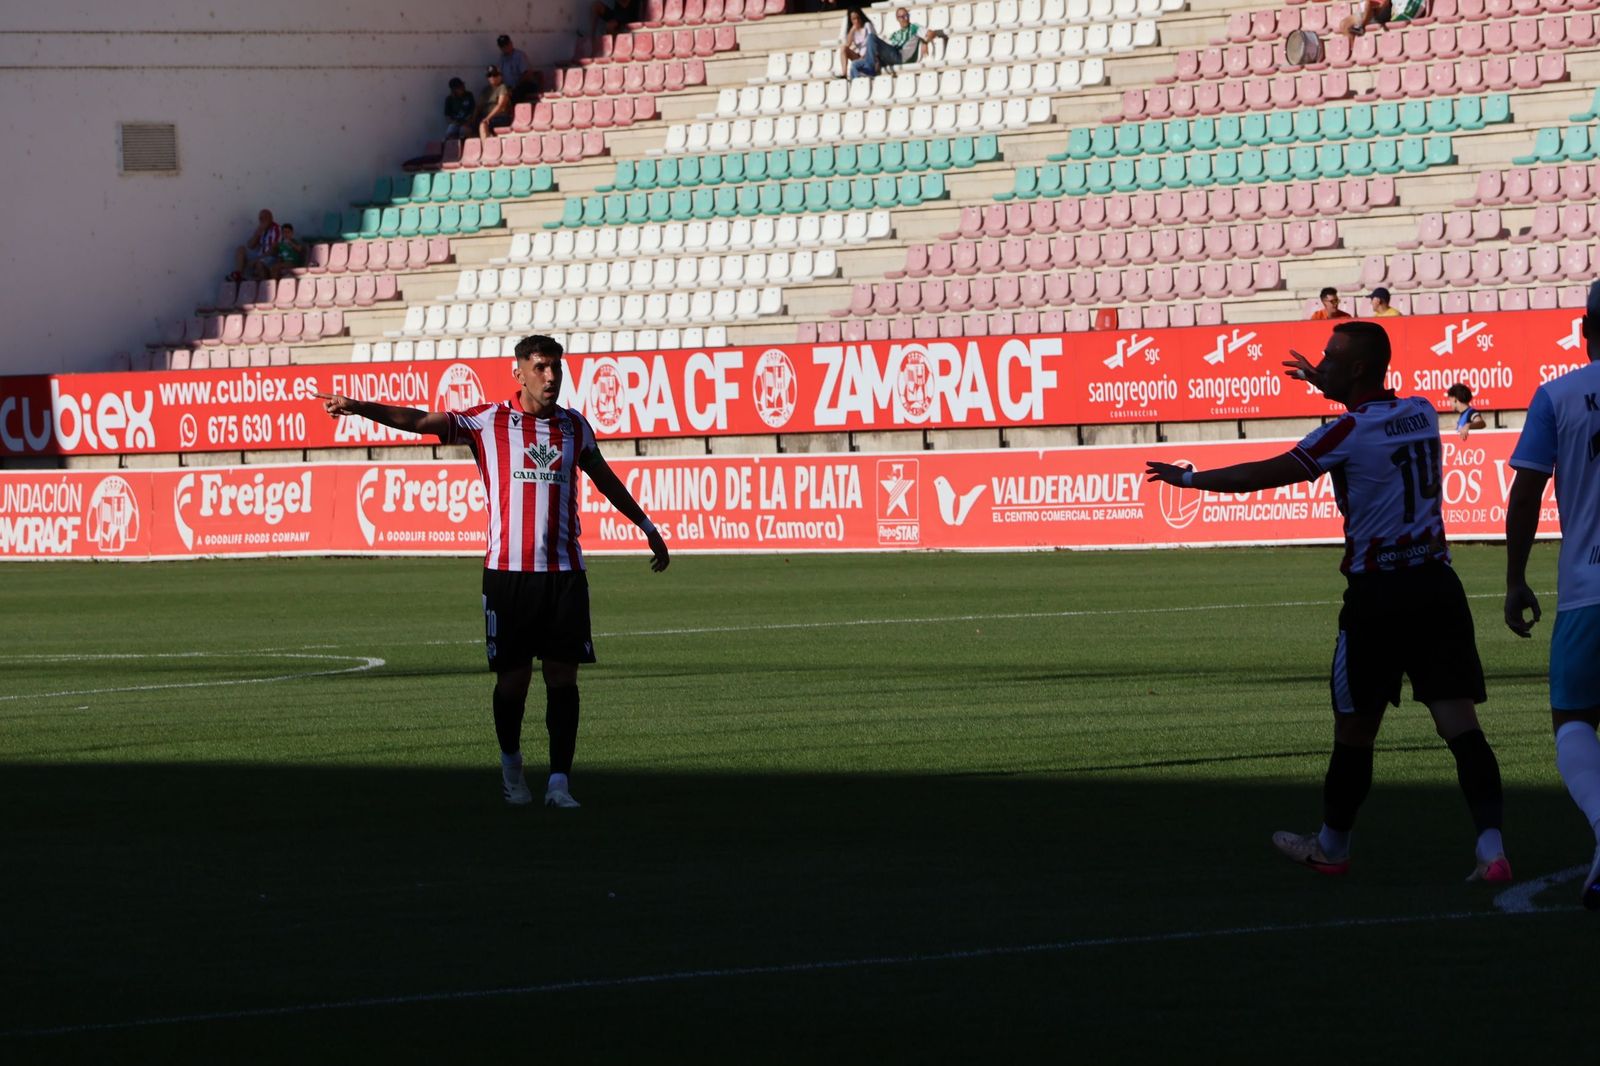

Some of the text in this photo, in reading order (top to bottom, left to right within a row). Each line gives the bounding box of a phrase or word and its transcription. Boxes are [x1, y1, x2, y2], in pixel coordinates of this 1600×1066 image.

[1145, 348, 1160, 365] sgc
[1247, 343, 1263, 360] sgc
[1476, 333, 1494, 351] sgc
[159, 372, 318, 406] www.cubiex.es
[332, 365, 429, 402] FUNDACIÓN
[560, 351, 743, 435] MORA CF
[812, 338, 1063, 426] ZAMORA CF
[1088, 374, 1178, 408] sangregorio
[1188, 370, 1281, 405] sangregorio
[1413, 361, 1513, 397] sangregorio
[0, 378, 156, 452] cubiex
[207, 415, 239, 444] 675
[242, 413, 272, 443] 630
[277, 412, 305, 441] 110
[513, 471, 569, 483] CAJA RURAL
[725, 466, 752, 510] DE
[760, 466, 787, 510] LA
[795, 465, 863, 509] PLATA
[991, 473, 1144, 505] VALDERADUEY
[1274, 471, 1335, 500] ALVA
[1442, 468, 1483, 505] OS
[200, 471, 312, 525] Freigel
[382, 468, 486, 523] Freige
[677, 514, 704, 540] del
[709, 515, 750, 539] Vino
[756, 514, 844, 541] (Zamora)
[993, 508, 1143, 522] EL CENTRO COMERCIAL DE ZAMORA
[1203, 502, 1308, 522] CONTRUCCIONES
[1442, 508, 1470, 523] UESO
[1472, 508, 1487, 522] DE
[197, 532, 310, 545] A GOODLIFE FOODS COMPANY
[378, 531, 487, 542] A GOODLIFE FOODS COMPA
